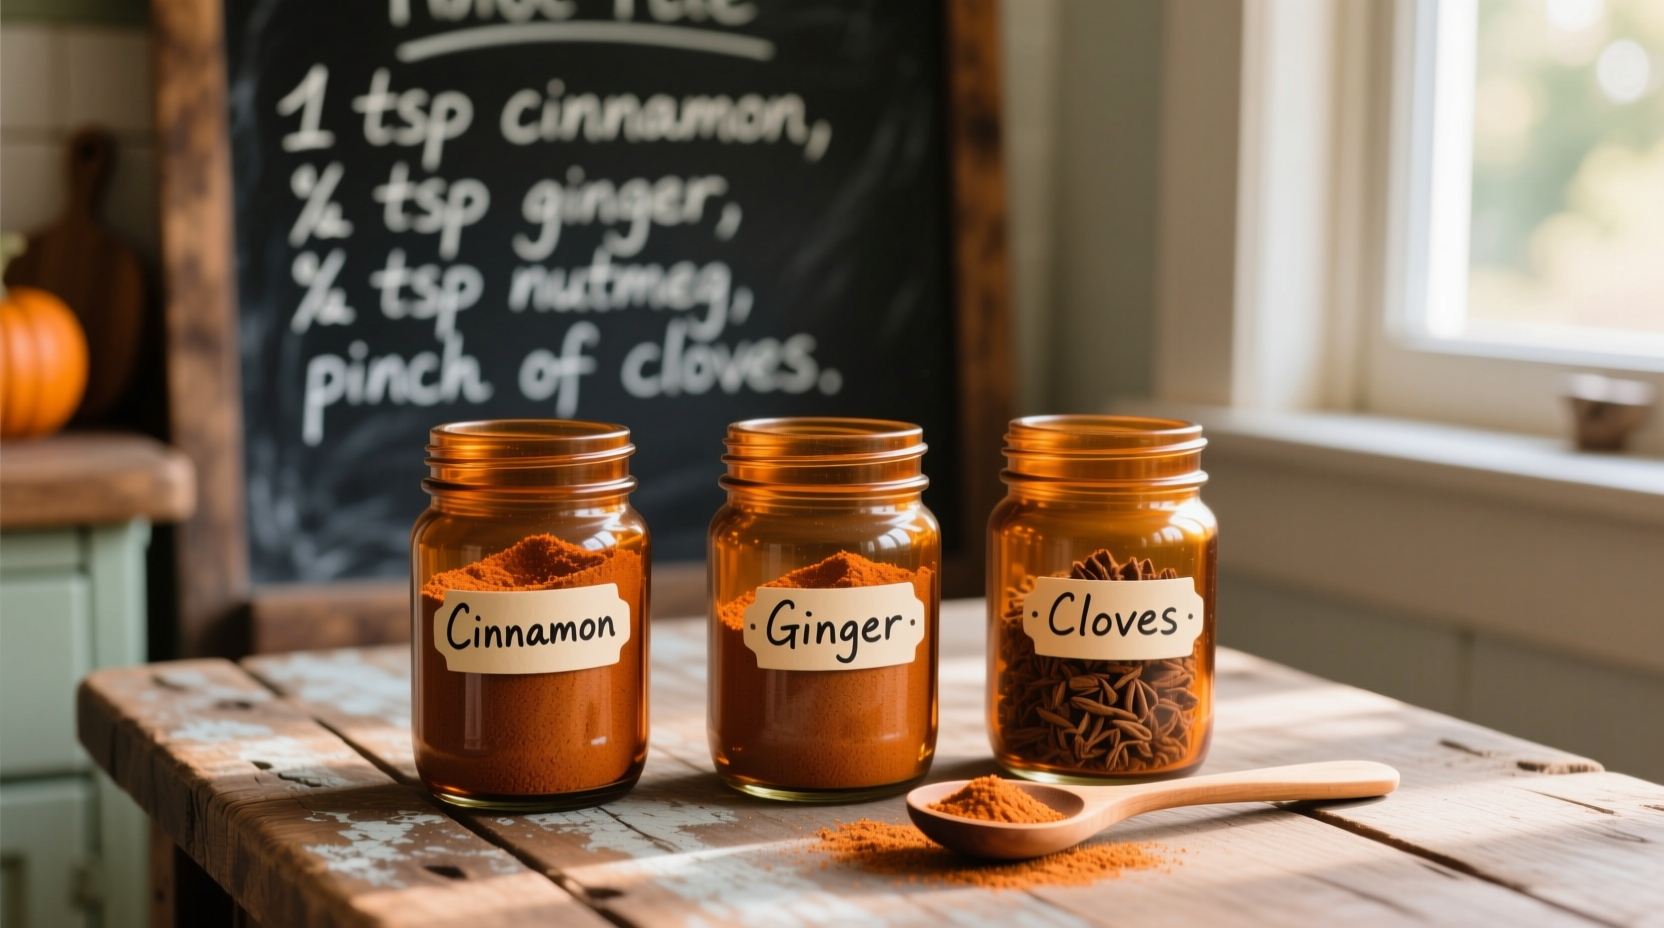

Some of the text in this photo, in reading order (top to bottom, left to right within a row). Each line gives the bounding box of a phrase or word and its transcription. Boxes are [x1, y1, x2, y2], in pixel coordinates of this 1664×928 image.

[276, 63, 832, 172] 1 tsp cinnamon,
[372, 161, 490, 260] tsp
[512, 165, 742, 261] ginger,
[369, 248, 484, 342] tsp
[508, 245, 754, 341] nutmeg,
[302, 317, 843, 446] pinch of cloves.
[446, 602, 616, 650] Cinnamon
[766, 599, 903, 664] Ginger
[1048, 591, 1178, 637] Cloves
